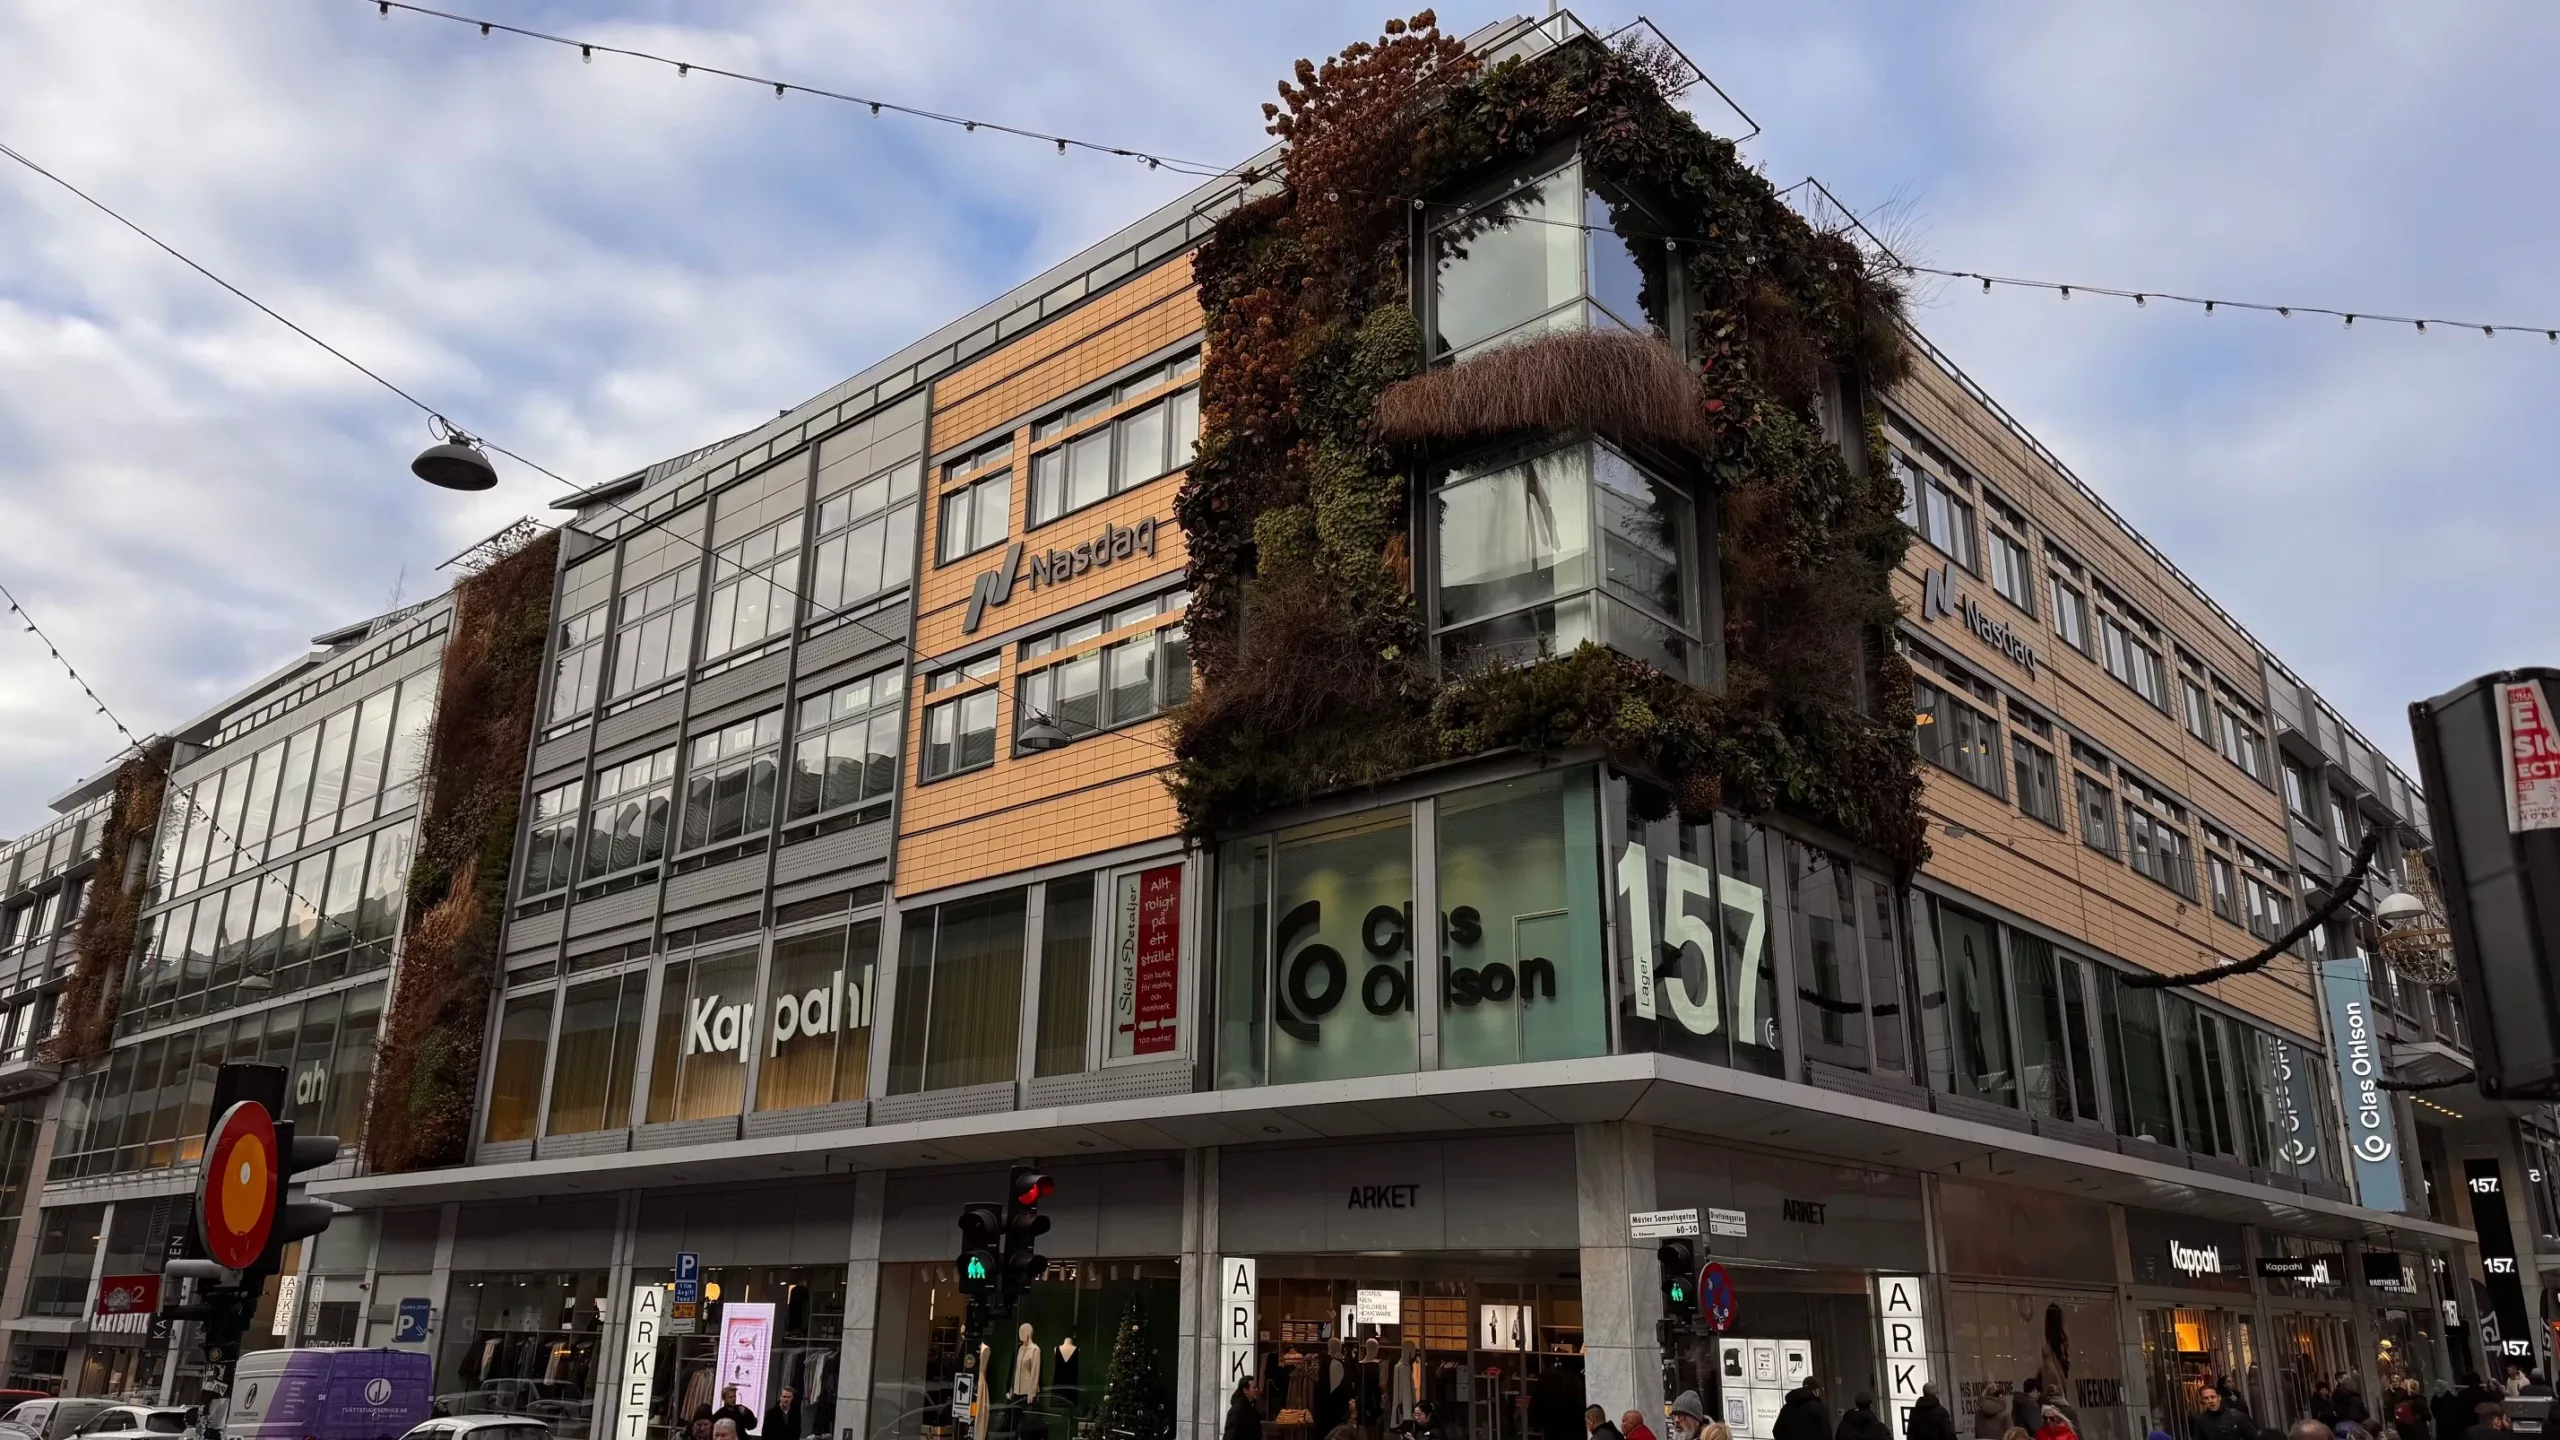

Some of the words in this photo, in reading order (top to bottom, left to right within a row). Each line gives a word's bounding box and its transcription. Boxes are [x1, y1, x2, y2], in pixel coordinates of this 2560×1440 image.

[1028, 516, 1155, 591] Nasdaq
[1963, 593, 2036, 682] Nasdaq
[1151, 876, 1171, 892] Allt
[1144, 896, 1176, 913] roligt
[1152, 912, 1166, 932] på
[1150, 934, 1168, 946] ett
[1618, 841, 1765, 1045] 157
[1141, 947, 1174, 966] ställe!
[1155, 970, 1171, 979] butik
[1641, 956, 1650, 1007] Lager
[1138, 1037, 1150, 1045] 100
[1152, 1034, 1171, 1043] meter
[2346, 1001, 2372, 1076] Ohlson
[2359, 1078, 2381, 1129] Clas
[1347, 1184, 1420, 1209] ARKET
[1654, 1212, 1696, 1224] Samuelsgatan
[1783, 1198, 1827, 1225] ARKET
[1676, 1225, 1698, 1234] 60-50
[2169, 1239, 2221, 1278] Kappahl
[2265, 1262, 2303, 1272] Kappahl
[2369, 1279, 2400, 1287] BROTHERS
[280, 1277, 296, 1335] ARKET
[627, 1290, 657, 1437] ARKET
[2074, 1378, 2122, 1409] WEEKDAY
